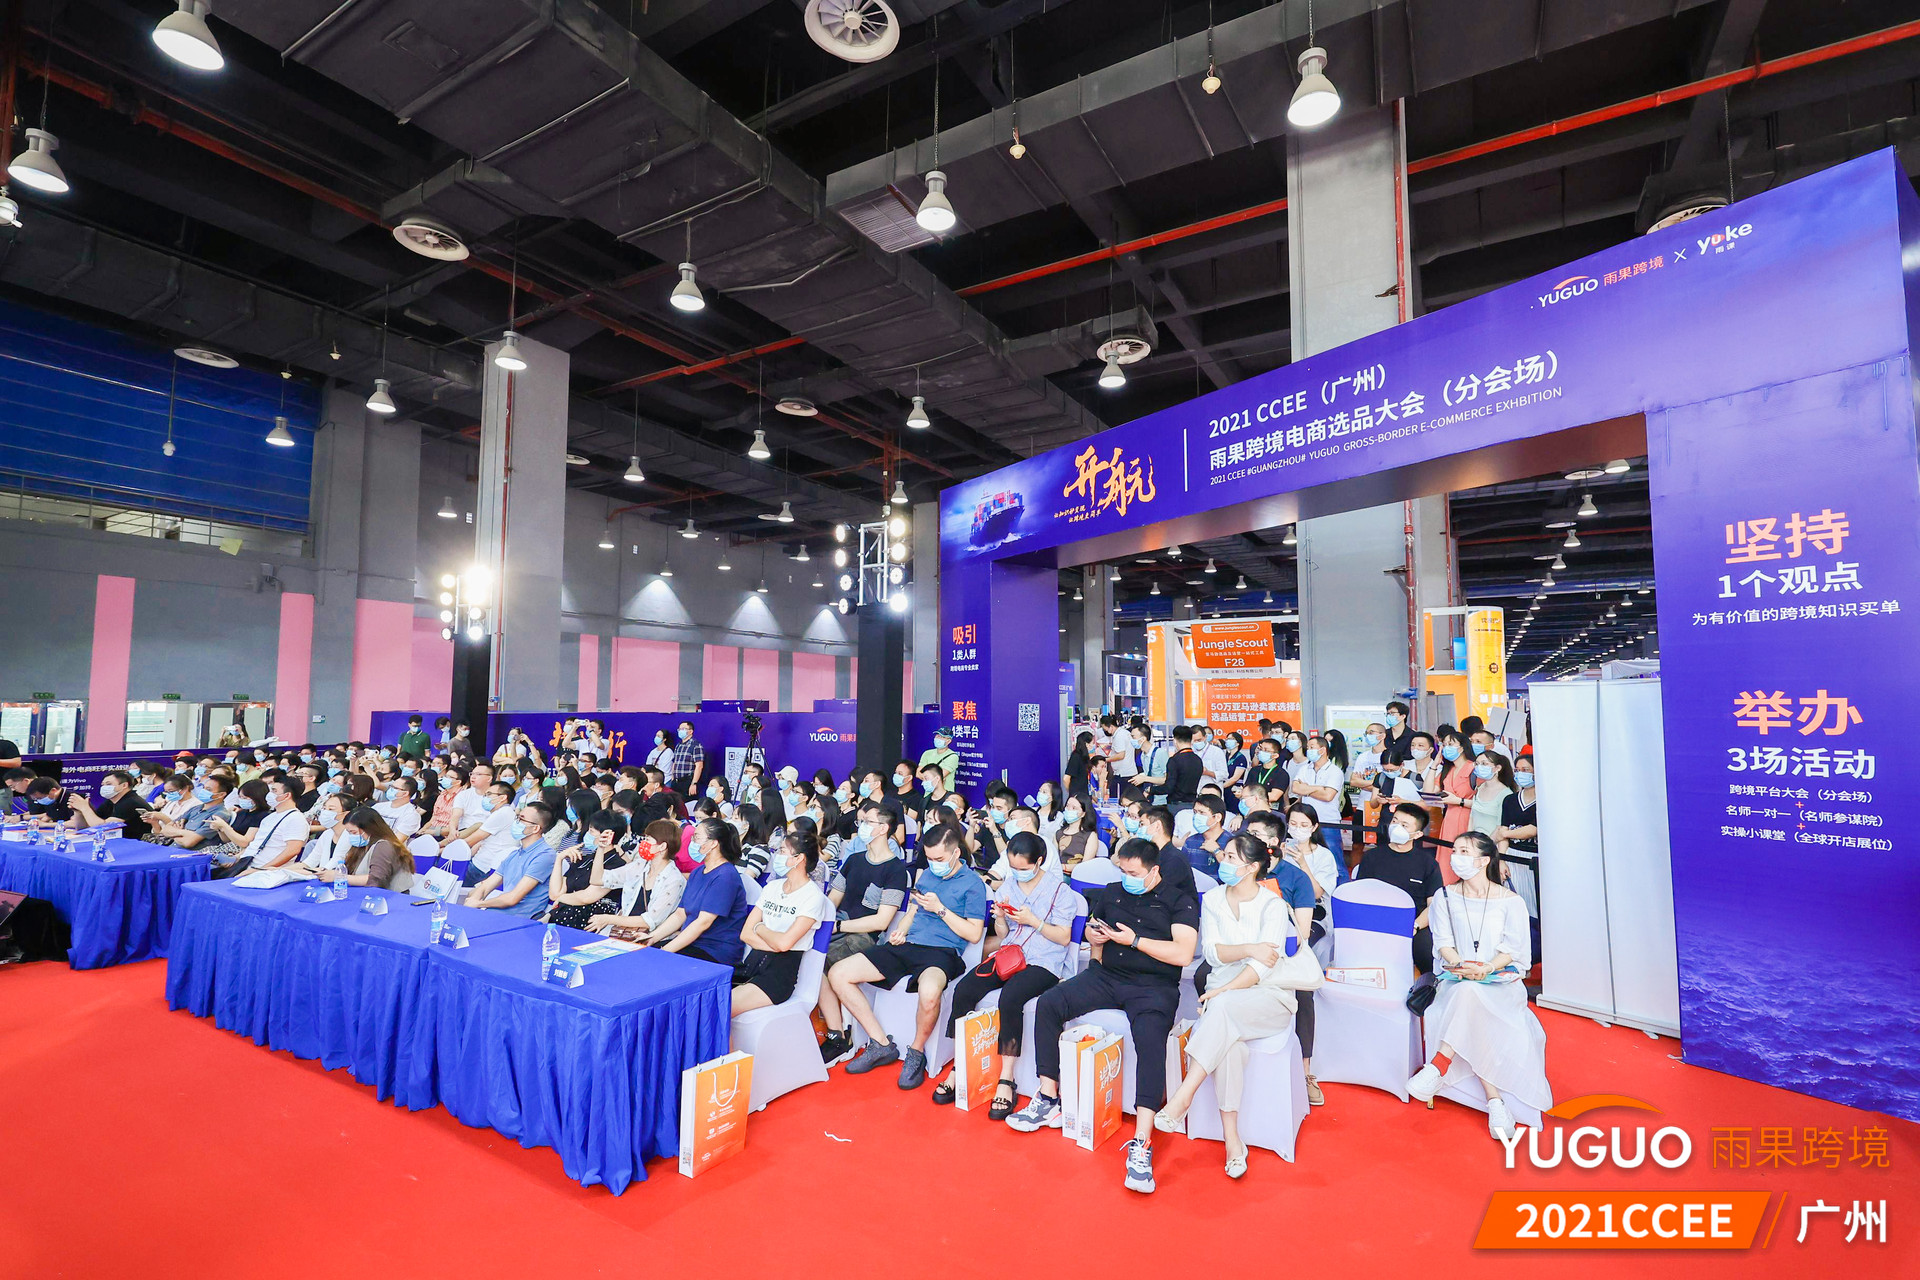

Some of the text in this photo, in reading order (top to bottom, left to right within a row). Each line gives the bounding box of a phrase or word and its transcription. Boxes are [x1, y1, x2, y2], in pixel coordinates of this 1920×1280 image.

[1538, 278, 1599, 307] YUGUO
[1603, 255, 1664, 287] 雨果跨境
[1697, 223, 1753, 255] yuke
[1209, 409, 1252, 438] 2021
[1210, 386, 1562, 485] 2021 CCEE #GUANGZHOU# YUGUO GROSS-BORDER E-COMMERCE EXHBITION
[1725, 508, 1850, 564] 坚持
[1718, 561, 1863, 599] 1个观点
[1692, 600, 1901, 626] 为有价值的跨境知识买单
[952, 623, 977, 645] 吸引
[1198, 638, 1268, 650] Jungle Scout
[952, 648, 977, 661] 1类人群
[1224, 658, 1245, 667] F28
[952, 700, 977, 721] 聚焦
[1732, 689, 1864, 736] 举办
[809, 732, 838, 742] YUGUO
[1726, 745, 1876, 780] 3场活动
